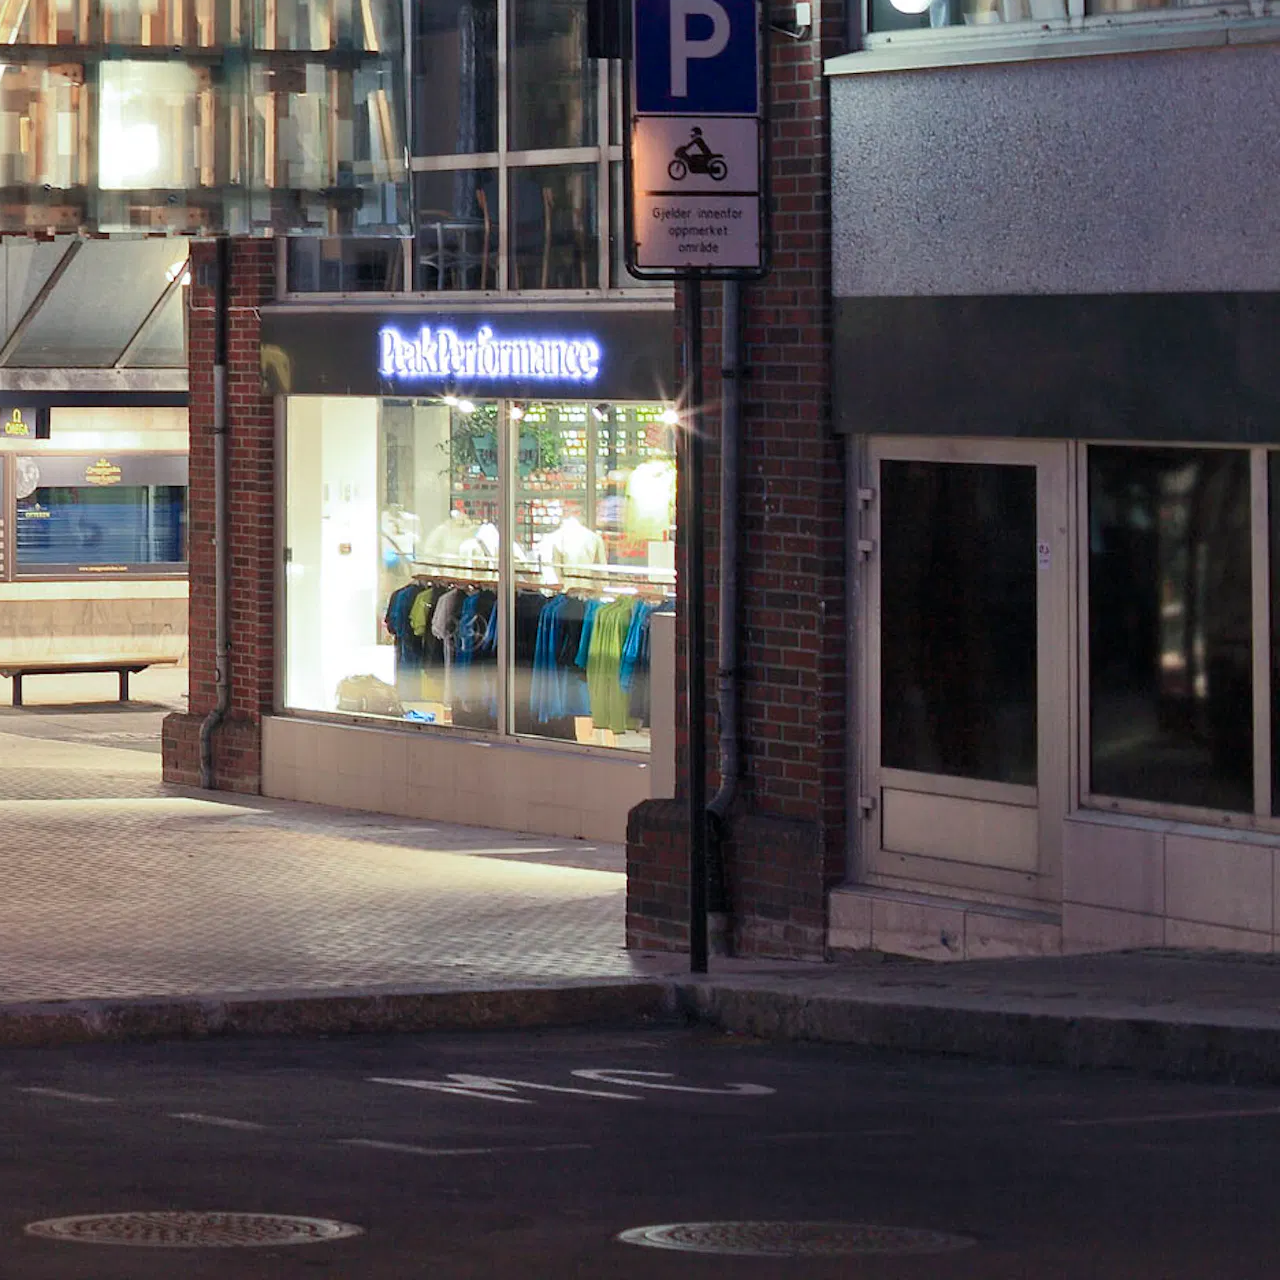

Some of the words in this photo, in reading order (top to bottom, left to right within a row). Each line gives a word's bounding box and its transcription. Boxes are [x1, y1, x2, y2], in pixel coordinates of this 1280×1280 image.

[652, 207, 692, 221] Gjelder
[697, 207, 743, 219] innenfor
[668, 225, 728, 237] oppmerket
[678, 241, 719, 253] område
[5, 422, 29, 435] OMEGA
